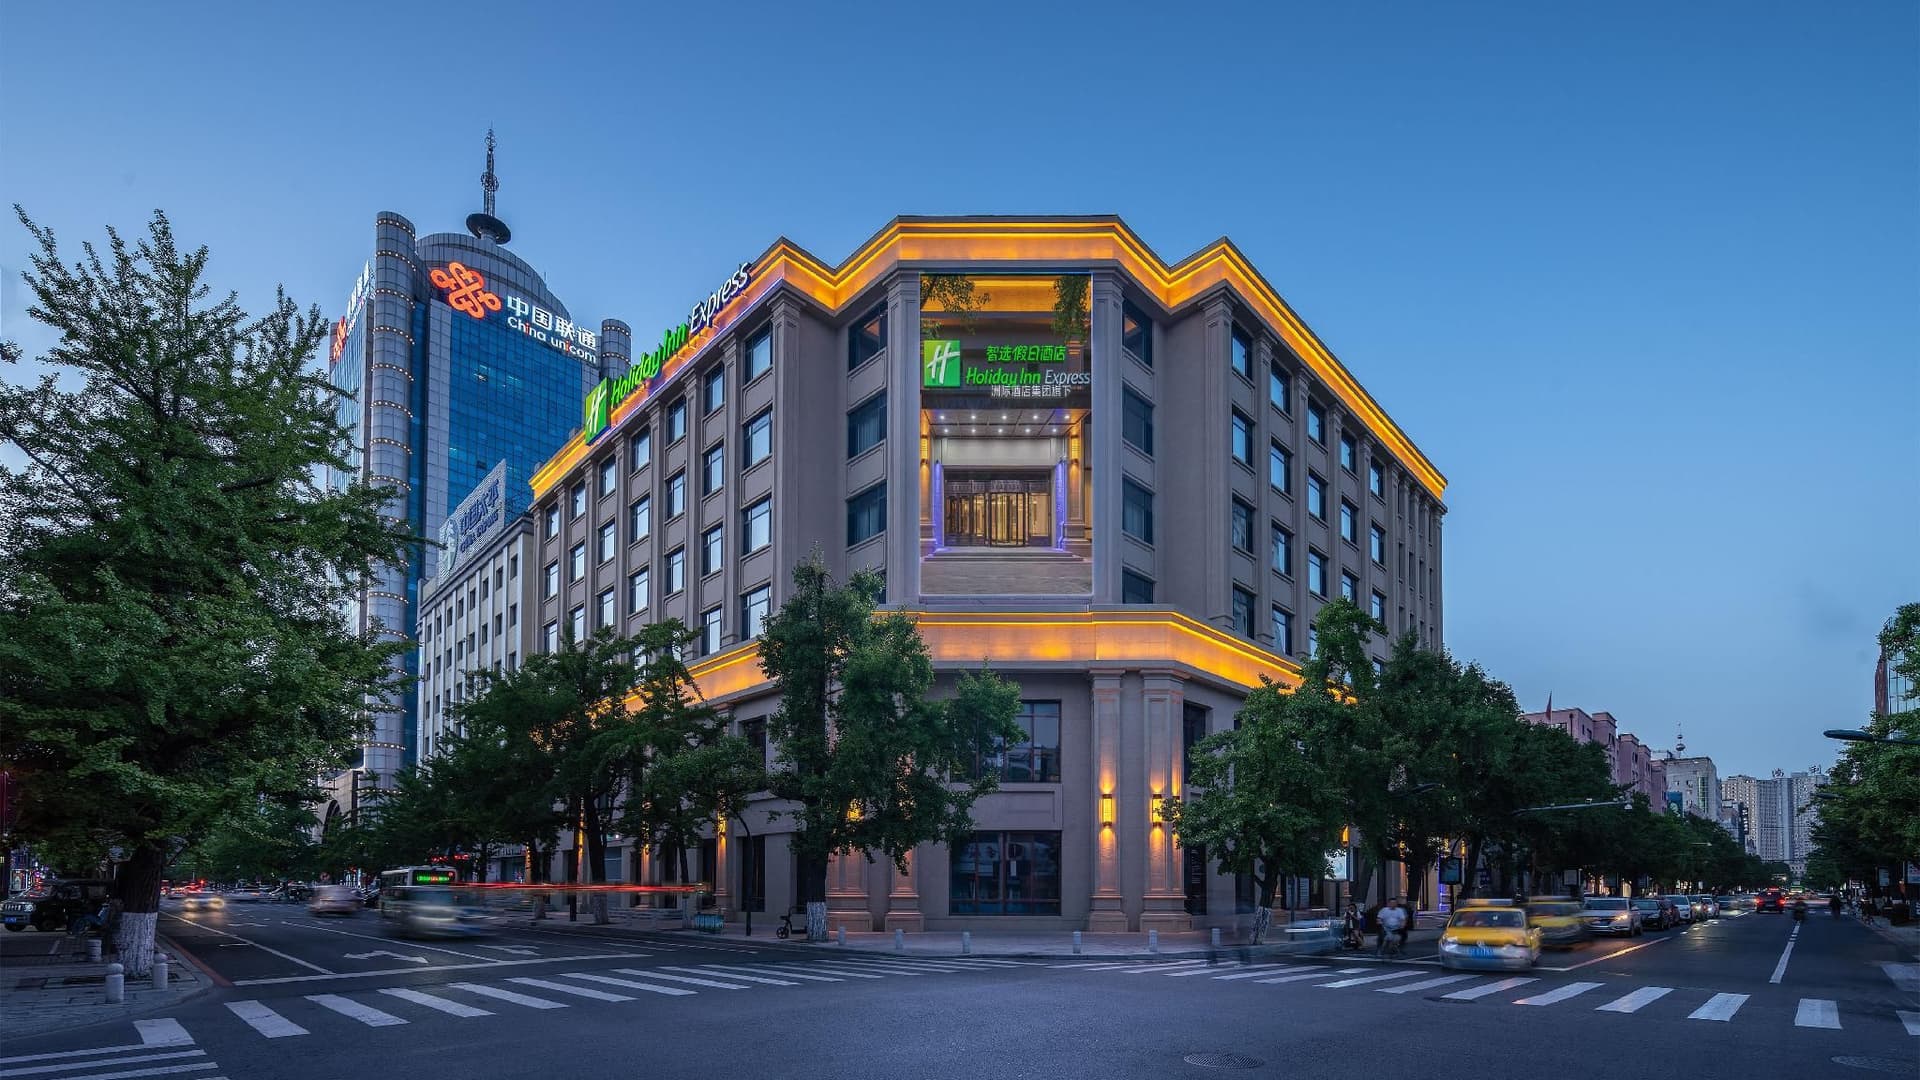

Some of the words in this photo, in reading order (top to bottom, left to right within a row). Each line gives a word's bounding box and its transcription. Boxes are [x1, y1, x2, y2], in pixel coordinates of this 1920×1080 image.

[507, 295, 597, 350] 中国联通
[611, 345, 662, 408] Holiday
[662, 322, 688, 361] Inn
[690, 262, 752, 334] Express
[507, 316, 546, 342] China
[551, 335, 597, 364] unicom
[985, 344, 1066, 363] 智选假日酒店
[965, 367, 1018, 387] Holiday
[1019, 369, 1041, 385] Inn
[1044, 369, 1091, 386] Express
[991, 385, 1072, 399] 洲际酒店集团旗下
